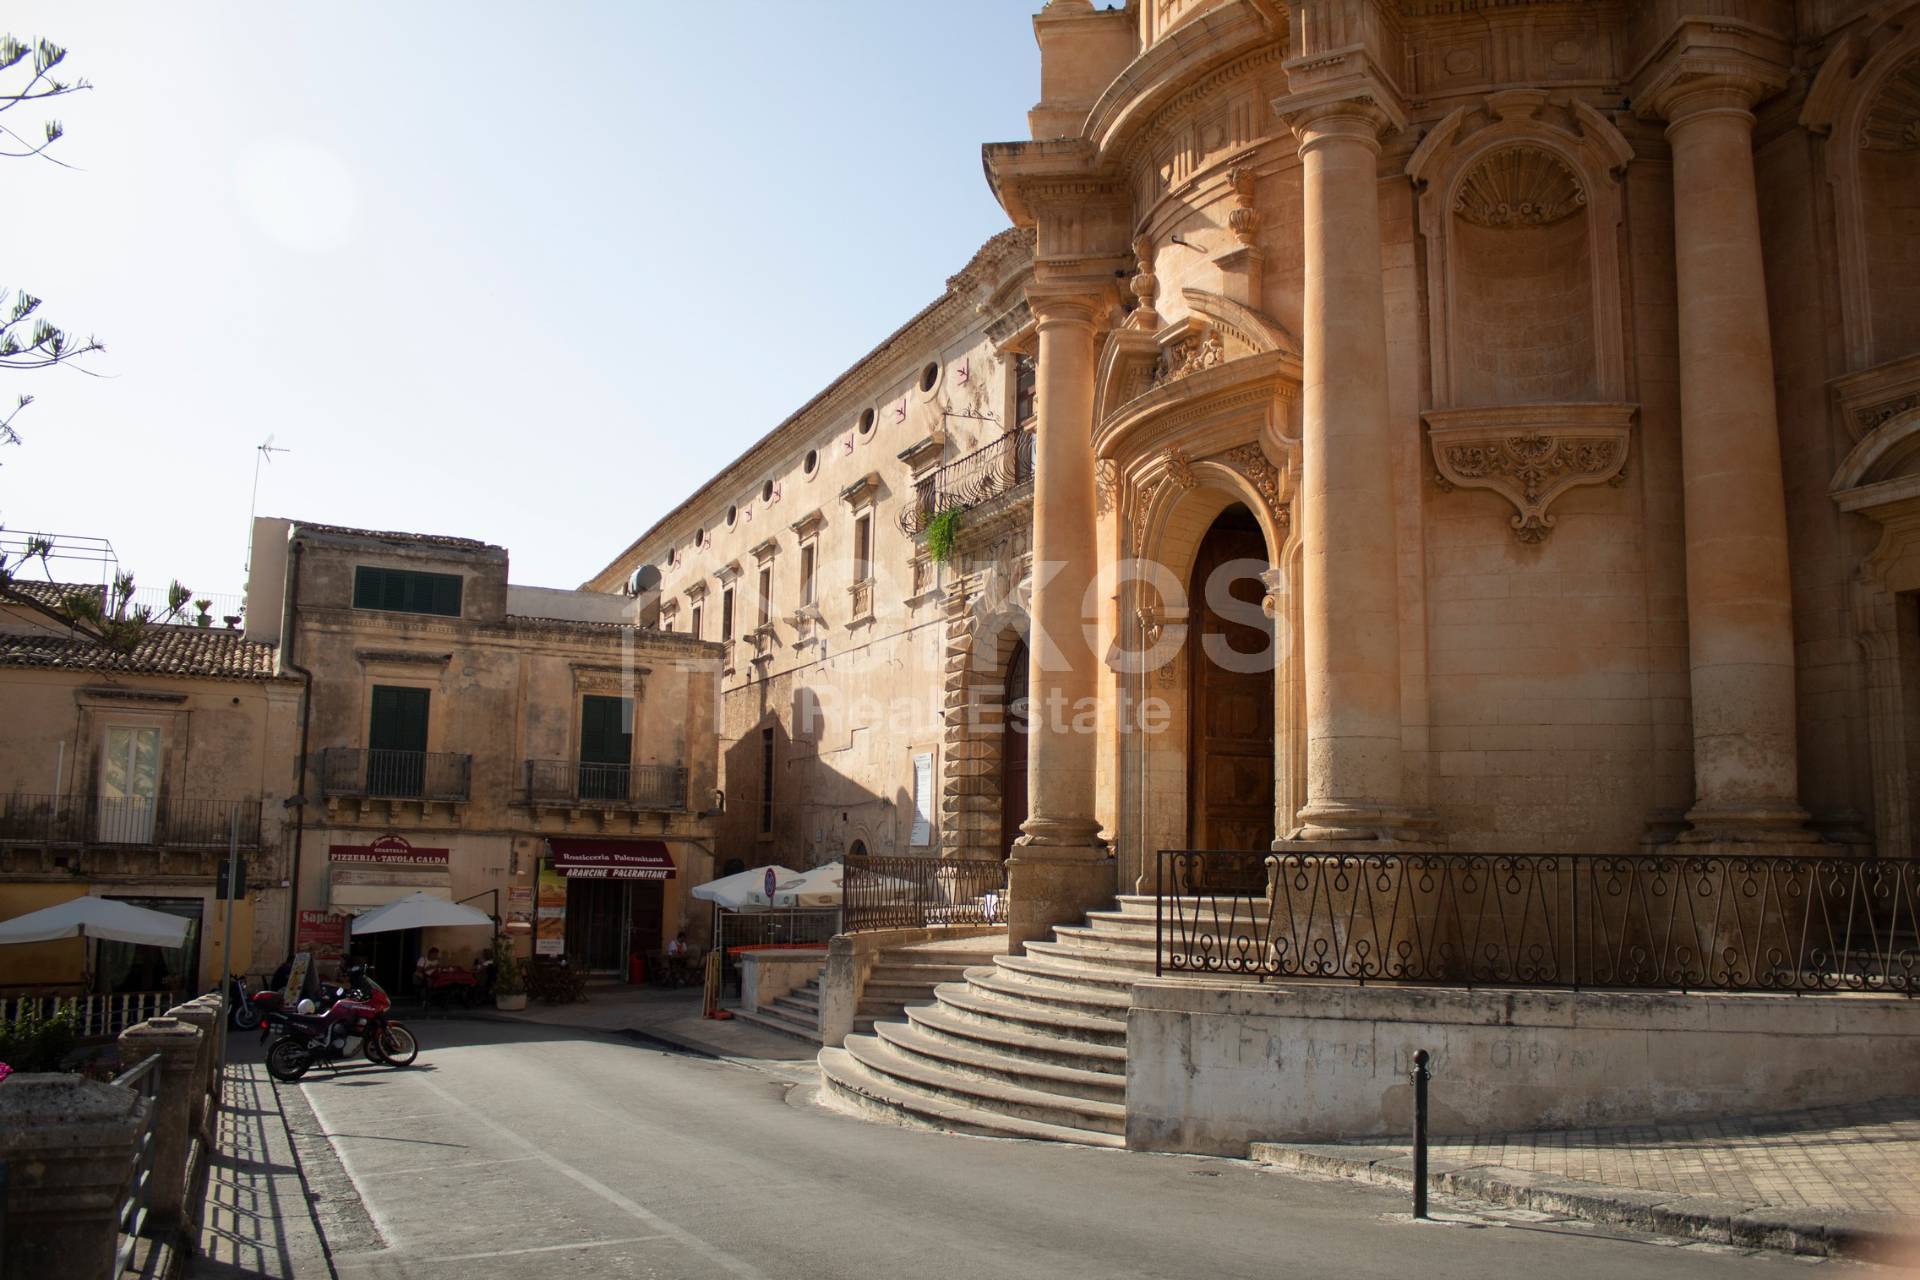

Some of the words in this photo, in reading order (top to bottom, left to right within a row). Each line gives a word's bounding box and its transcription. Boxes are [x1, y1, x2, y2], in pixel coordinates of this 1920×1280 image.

[416, 856, 447, 864] CALDA
[563, 853, 610, 861] Rosticceria
[614, 854, 664, 863] Palermitana
[566, 868, 609, 877] ARANCINE
[612, 869, 668, 879] PALERMITANE
